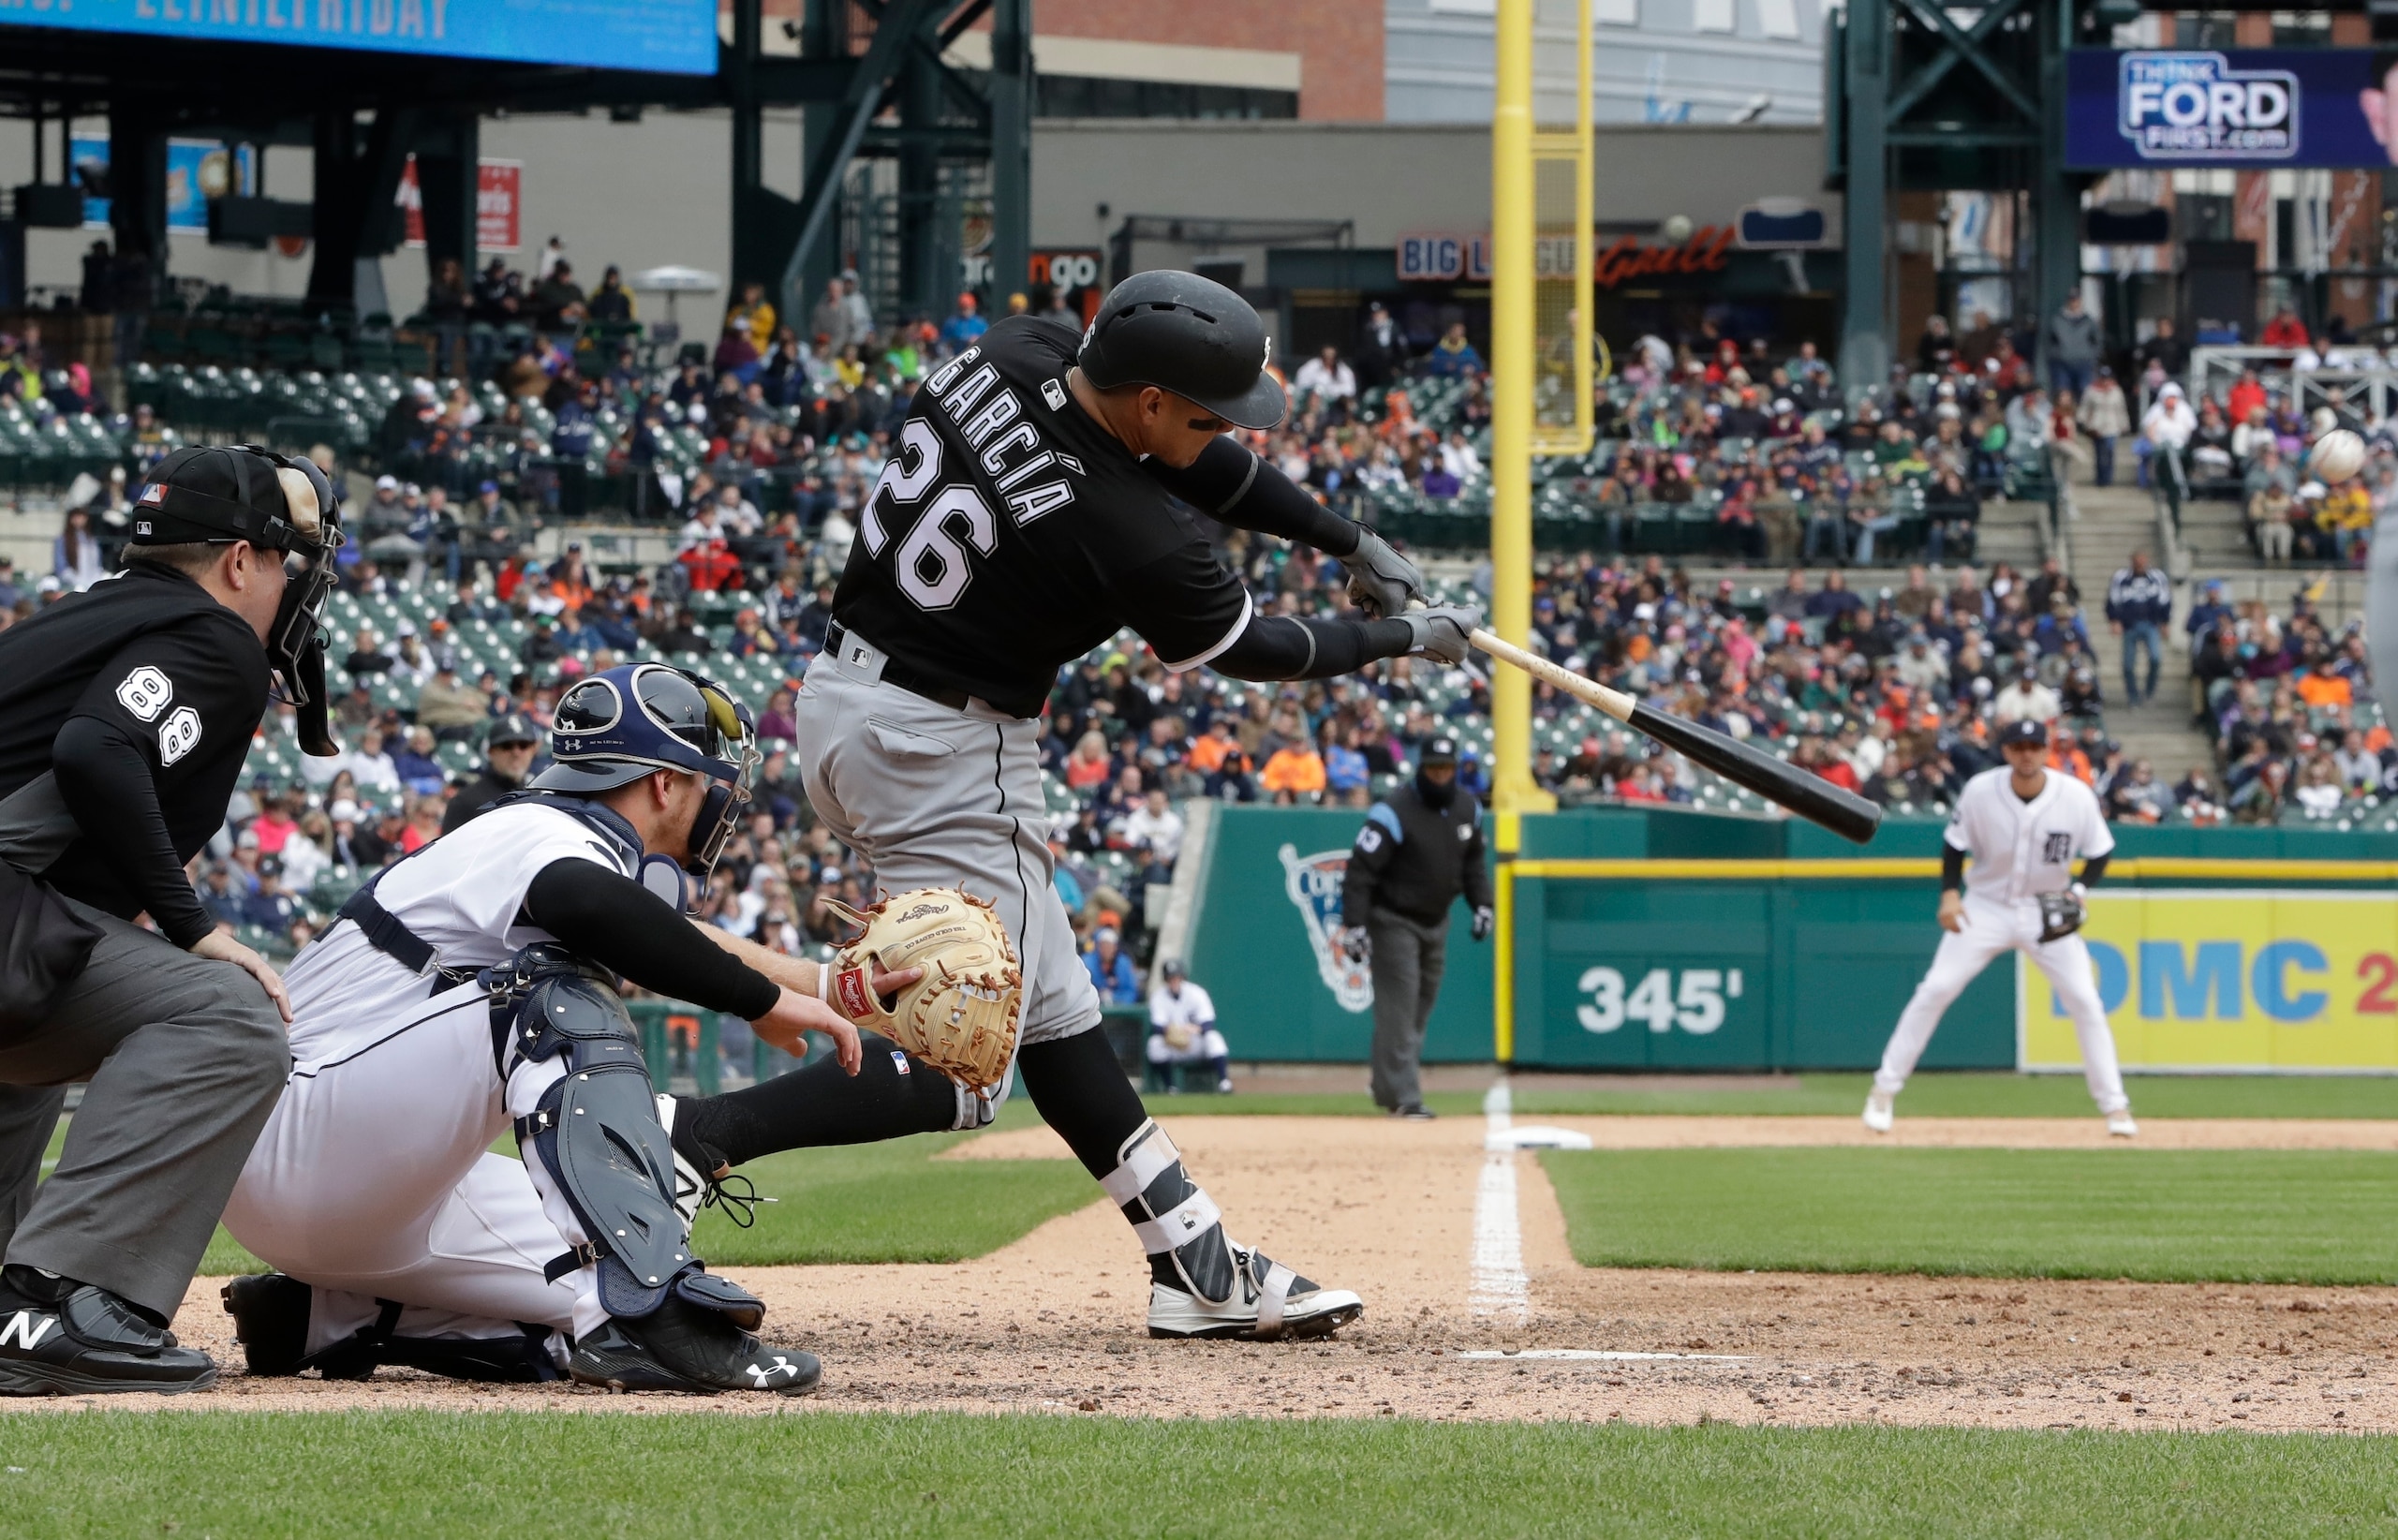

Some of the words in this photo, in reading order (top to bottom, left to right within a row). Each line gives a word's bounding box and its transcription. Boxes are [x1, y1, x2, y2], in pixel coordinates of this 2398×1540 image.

[2128, 82, 2289, 127] FORD
[1401, 238, 1459, 274] BIG
[926, 345, 1087, 528] GARCÍA
[860, 416, 999, 612] 26
[115, 666, 202, 767] 88
[896, 904, 949, 925] Rawlings
[1576, 965, 1743, 1034] 345'
